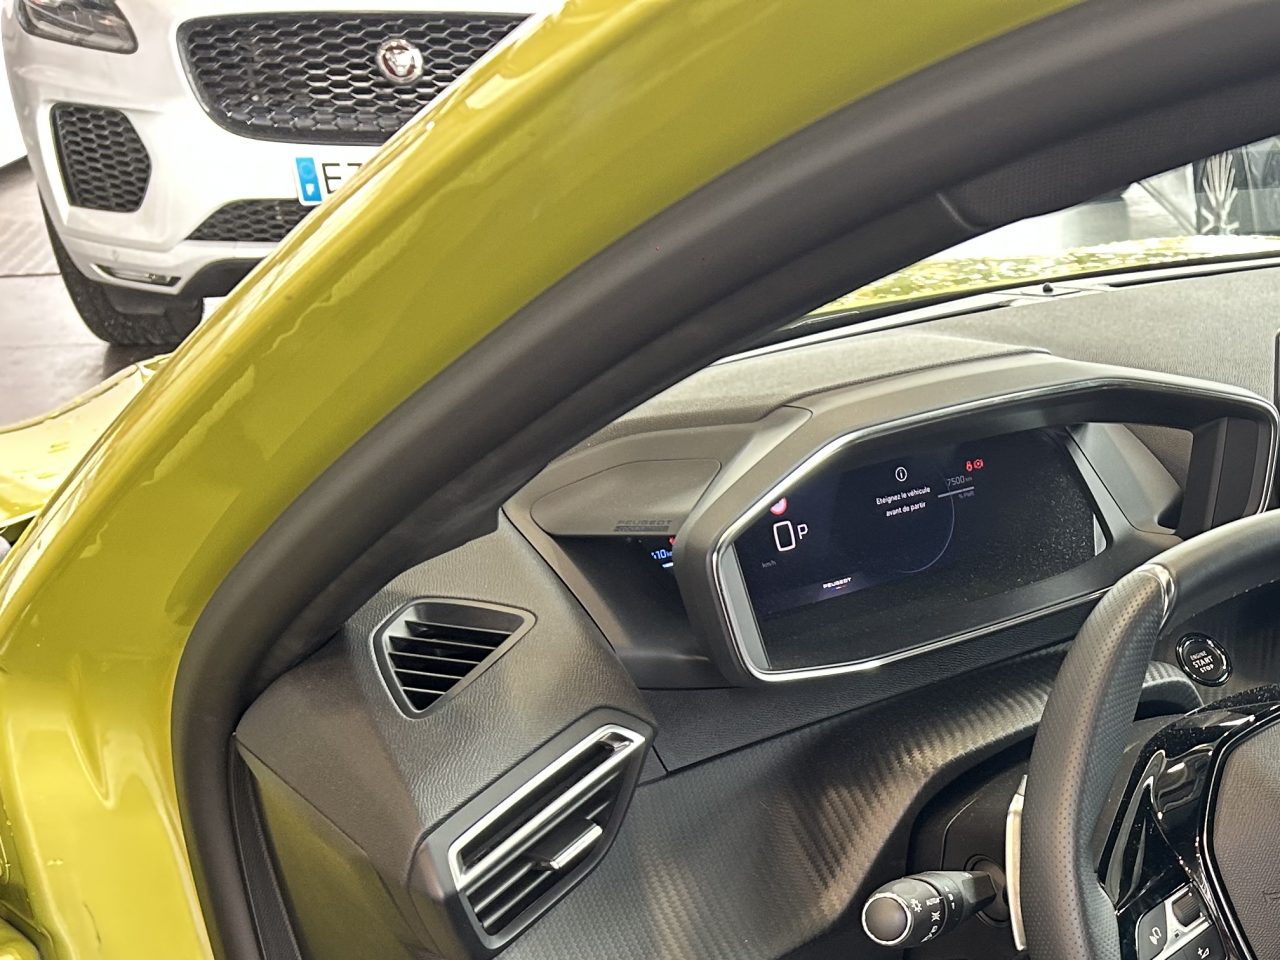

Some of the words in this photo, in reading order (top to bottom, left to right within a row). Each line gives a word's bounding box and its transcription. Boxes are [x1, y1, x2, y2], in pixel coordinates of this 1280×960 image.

[322, 163, 362, 194] E
[907, 486, 931, 497] véhicule
[886, 507, 903, 517] avant
[902, 505, 911, 513] de
[910, 501, 927, 513] partir
[797, 523, 809, 540] P
[822, 577, 852, 589] PEUGEOT
[1189, 650, 1208, 661] ENGINE
[1192, 655, 1214, 669] START
[1199, 663, 1214, 673] STOP
